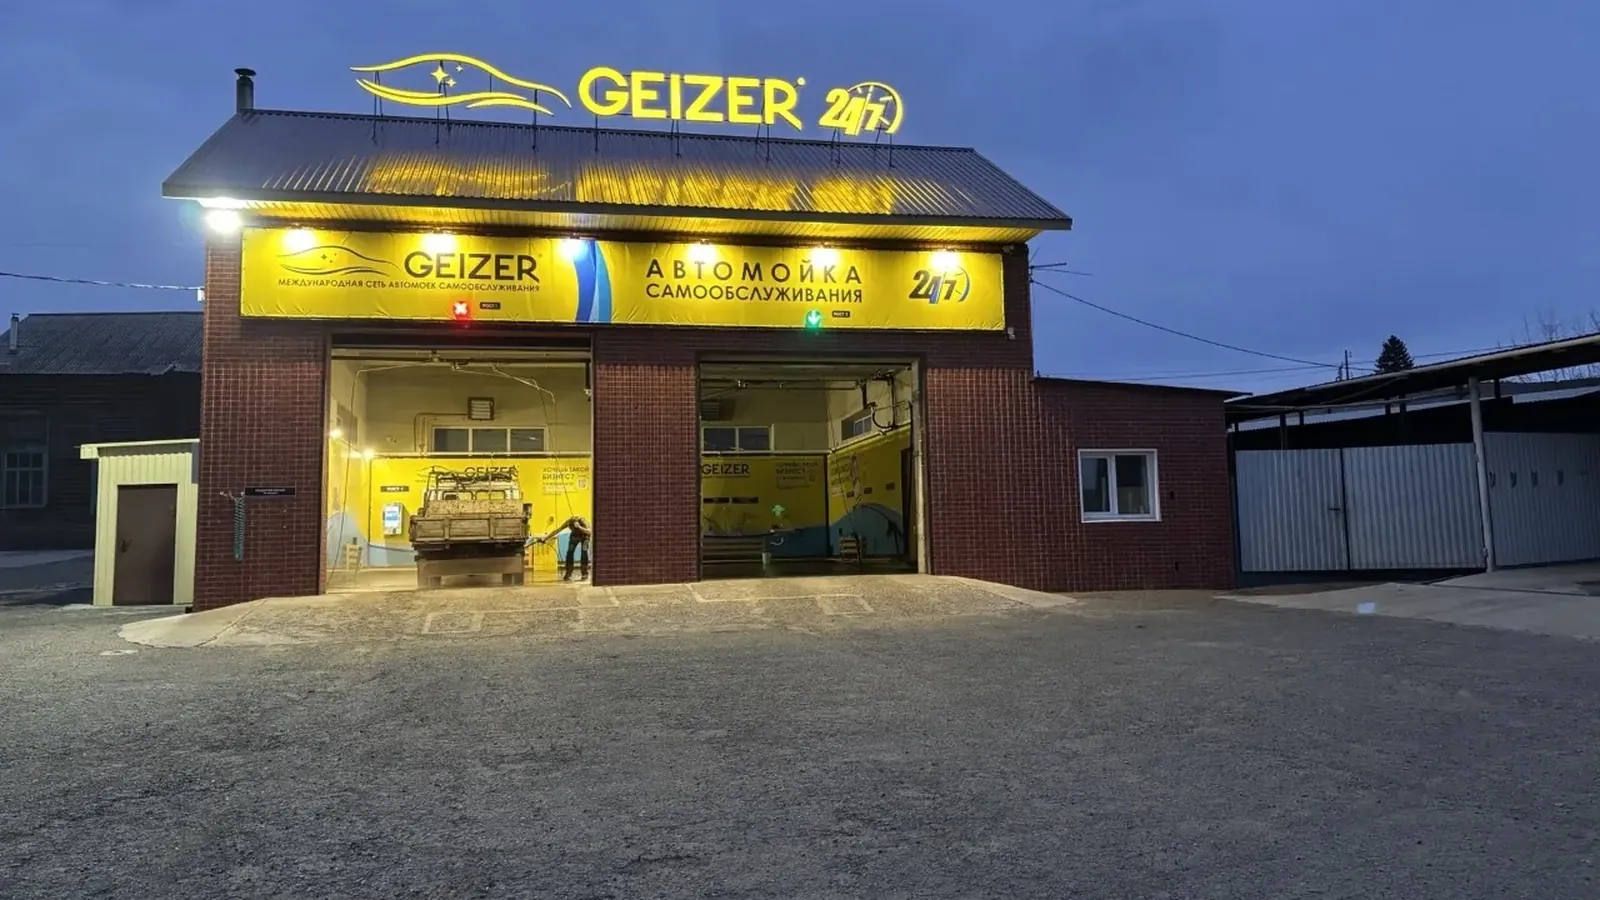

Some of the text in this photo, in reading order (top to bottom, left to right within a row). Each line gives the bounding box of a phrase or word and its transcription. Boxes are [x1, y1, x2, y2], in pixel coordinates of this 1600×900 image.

[578, 66, 802, 130] GEIZER
[404, 251, 540, 283] GEIZER
[646, 258, 862, 285] АВТОМОЙКА
[278, 278, 540, 292] МЕЖДУНАРОДНАЯ СЕТЬ АВТОМОЕК САМООБСЛУЖИВАНИЯ
[646, 283, 863, 303] САМООБСЛУЖИВАНИЯ
[701, 463, 750, 475] GEIZER
